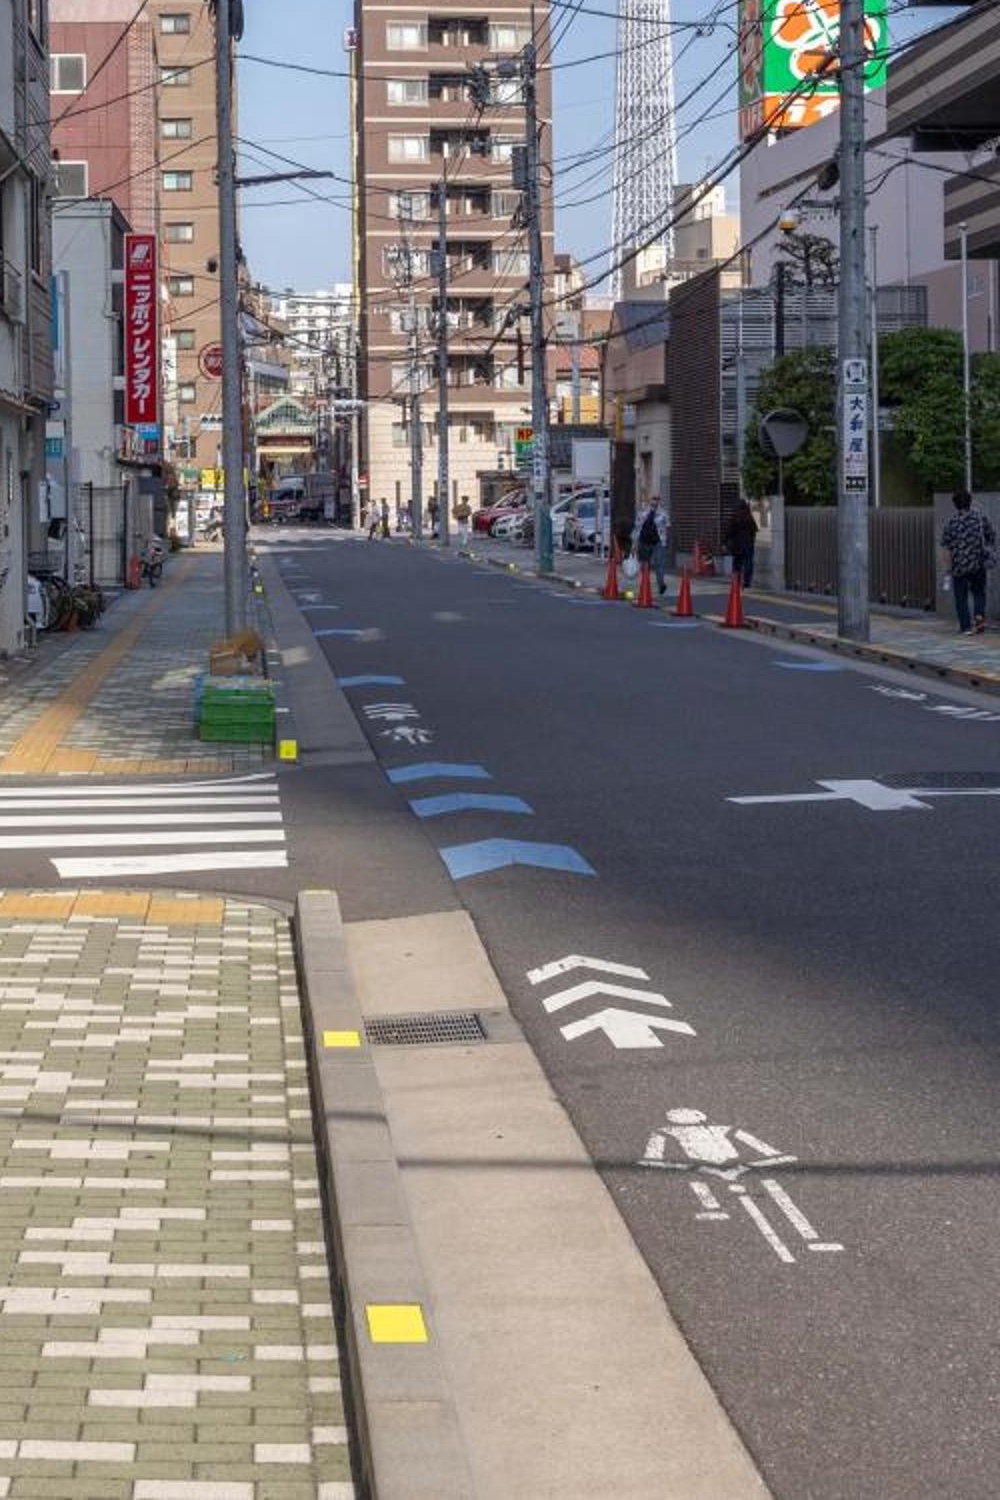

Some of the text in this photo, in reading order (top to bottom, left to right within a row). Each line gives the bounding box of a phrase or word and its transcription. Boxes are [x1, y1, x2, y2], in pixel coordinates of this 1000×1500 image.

[130, 274, 151, 413] ニッポンレンタカー
[849, 396, 865, 452] 大和屋
